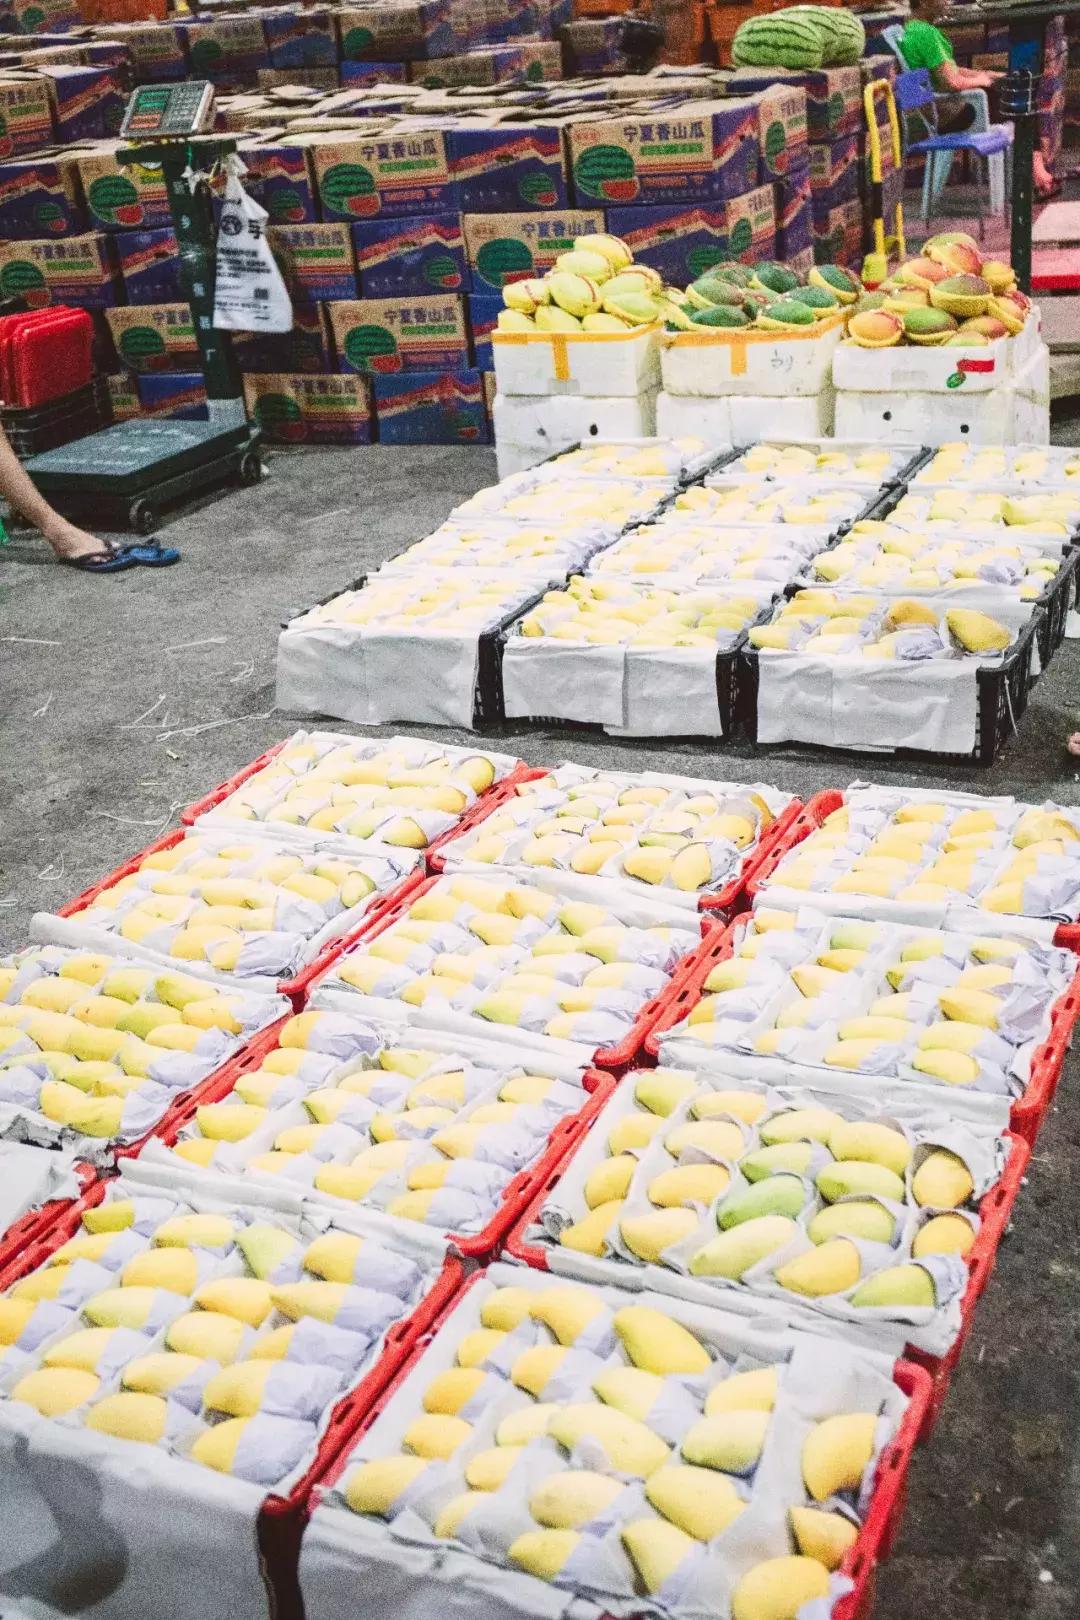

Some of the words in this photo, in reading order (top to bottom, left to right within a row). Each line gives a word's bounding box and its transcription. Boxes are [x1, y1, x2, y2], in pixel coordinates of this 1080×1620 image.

[623, 121, 705, 143] 宁夏香山瓜
[361, 139, 437, 161] 宁夏香山瓜
[521, 218, 598, 238] 宁夏香山瓜
[384, 306, 457, 325] 宁夏香山瓜
